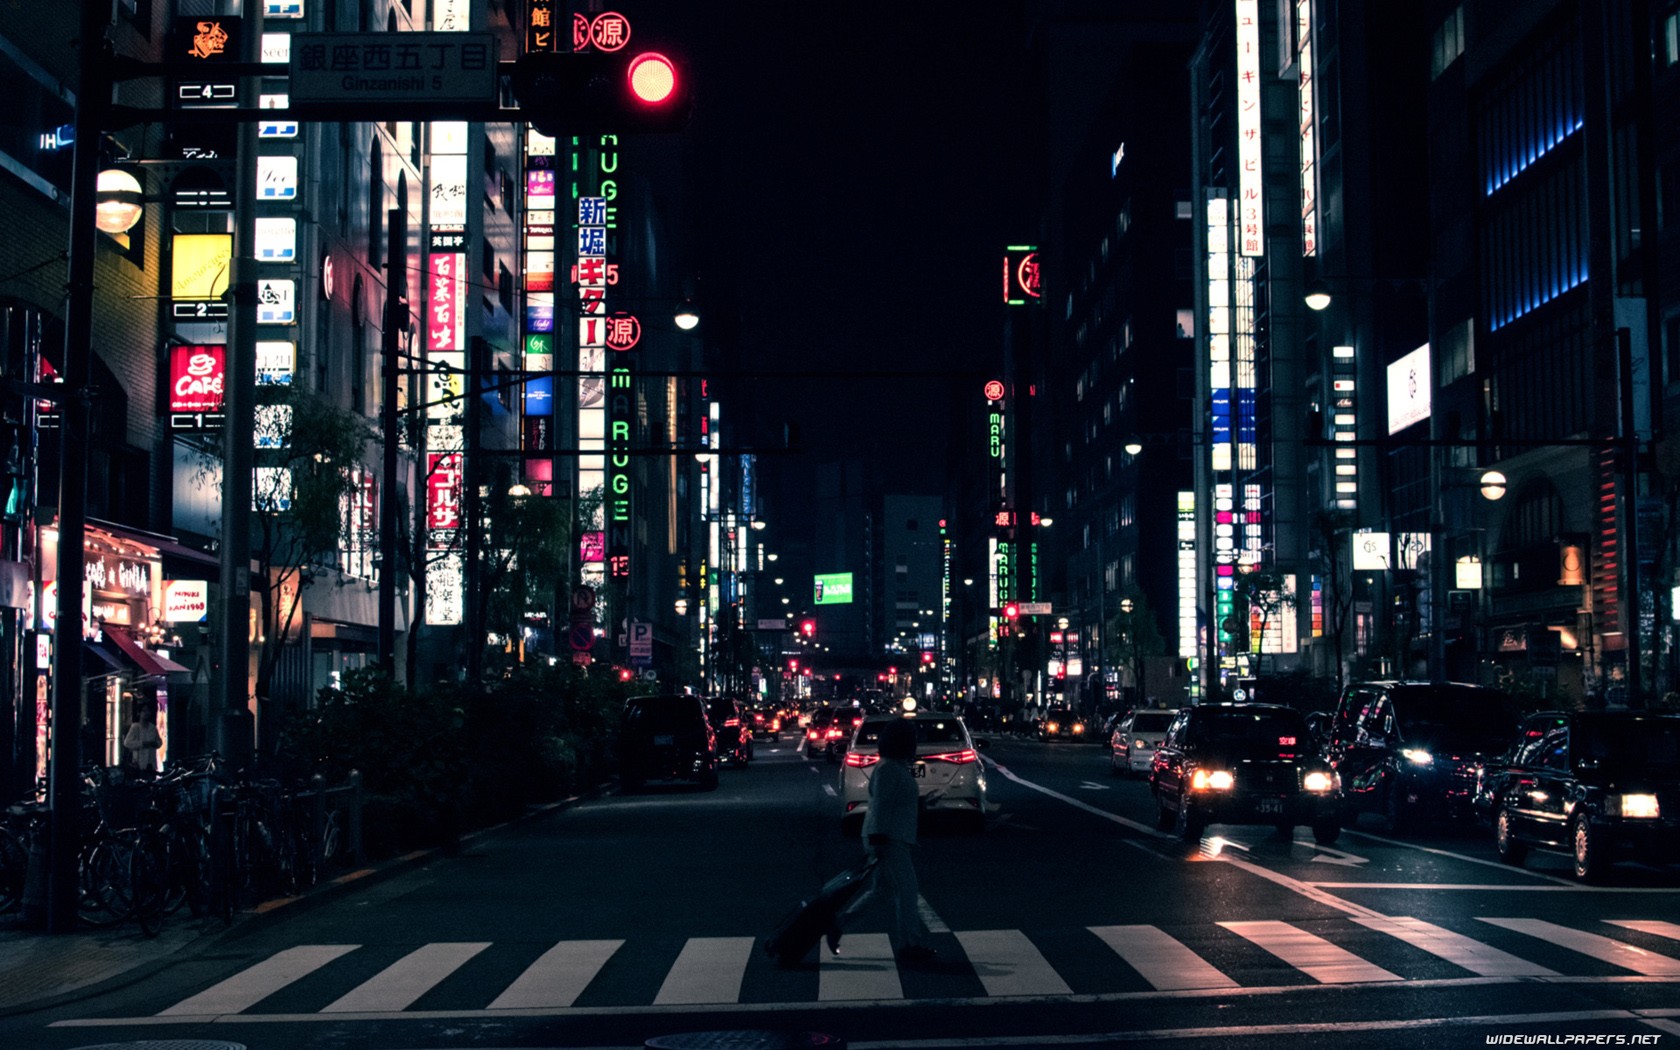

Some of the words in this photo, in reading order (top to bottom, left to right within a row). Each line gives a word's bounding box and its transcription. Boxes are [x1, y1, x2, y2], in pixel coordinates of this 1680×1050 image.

[594, 16, 627, 49] 源
[300, 43, 487, 72] 銀座西五丁目
[202, 85, 212, 98] 4
[341, 76, 425, 92] Ginzanishi
[432, 76, 442, 90] 5
[1241, 0, 1259, 252] ユーギンザビル3号館
[579, 198, 605, 345] 新堀ギター
[196, 303, 207, 317] 2
[606, 316, 637, 347] 源
[194, 414, 202, 427] 1
[989, 413, 1000, 458] MARU
